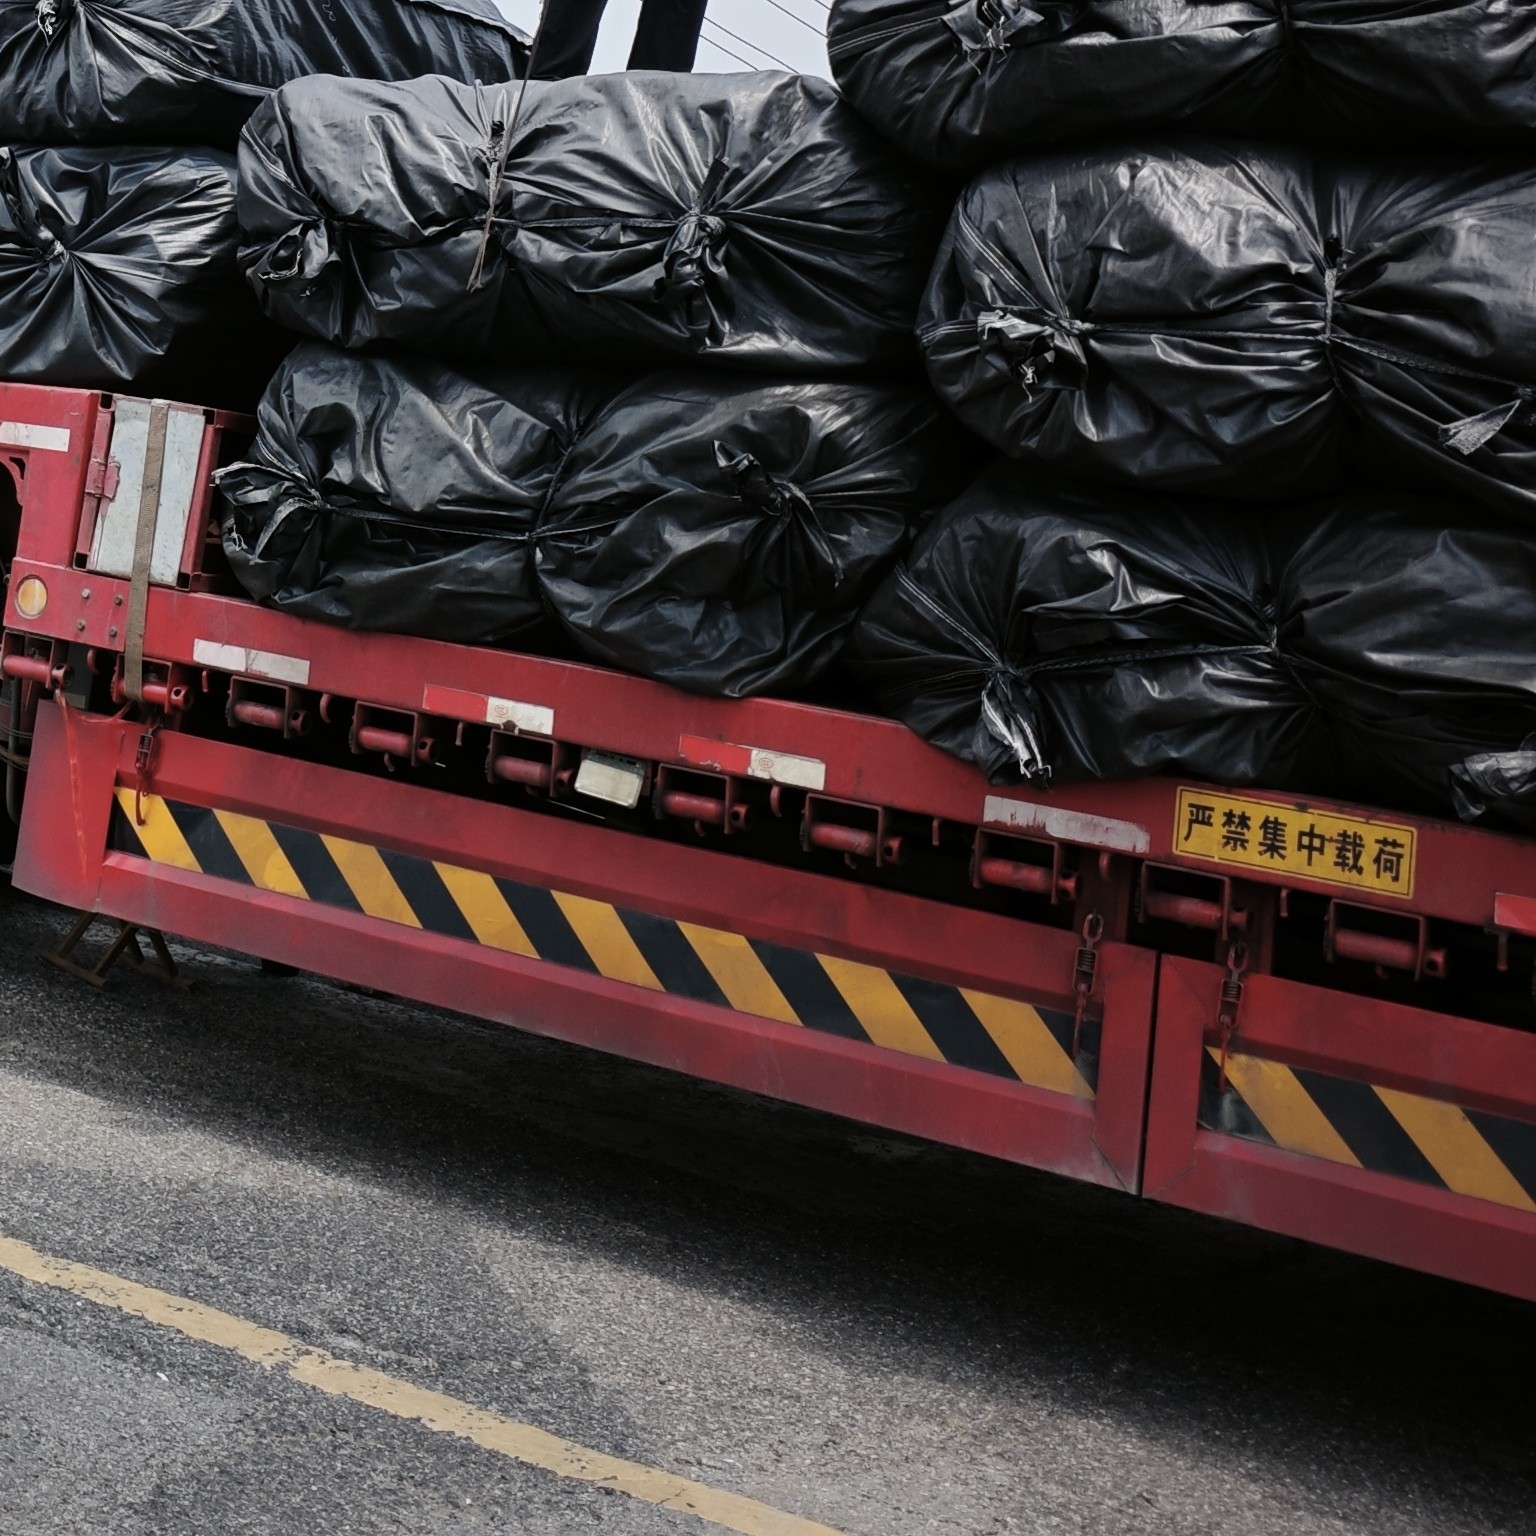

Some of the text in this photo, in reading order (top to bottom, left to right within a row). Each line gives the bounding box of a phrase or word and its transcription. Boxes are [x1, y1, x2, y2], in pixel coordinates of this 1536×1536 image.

[1183, 802, 1405, 883] 严禁集中载荷
